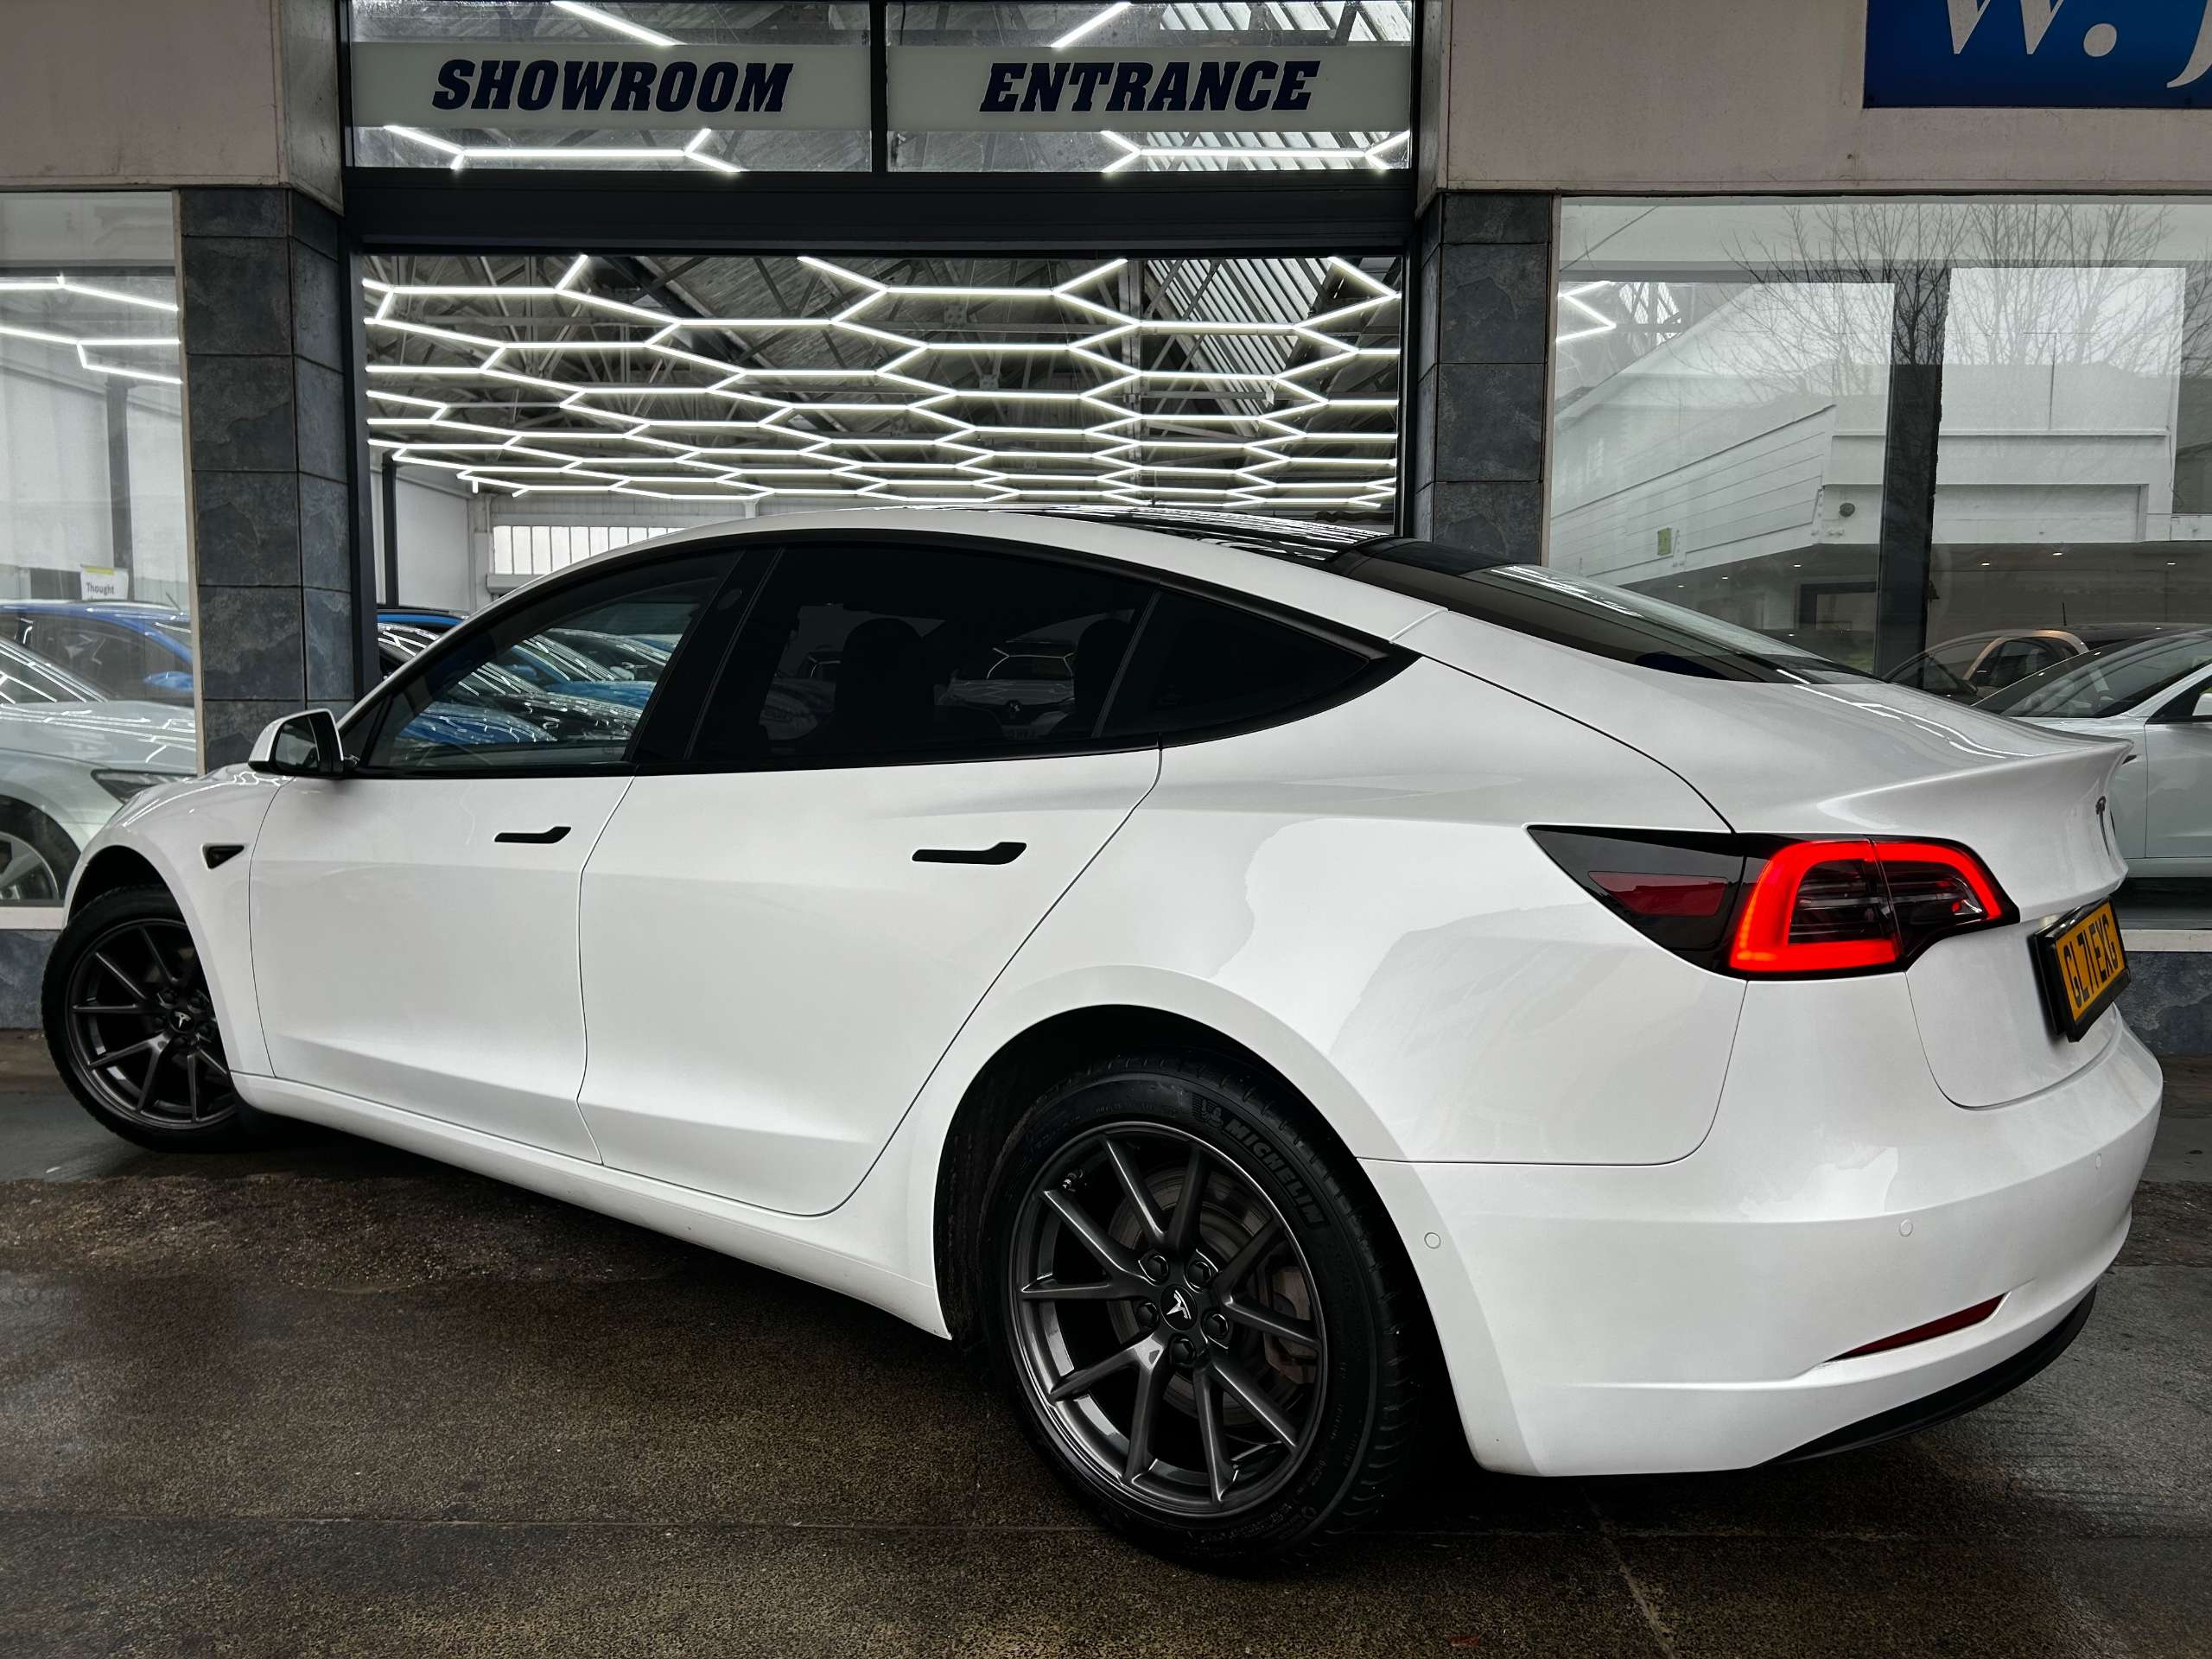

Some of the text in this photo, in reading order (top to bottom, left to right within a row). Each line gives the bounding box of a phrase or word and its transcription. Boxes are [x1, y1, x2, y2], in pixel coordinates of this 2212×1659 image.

[432, 60, 793, 112] SHOWROOM
[979, 60, 1320, 112] ENTRANCE
[86, 582, 115, 596] Thought
[1224, 1118, 1325, 1225] MICHELIN
